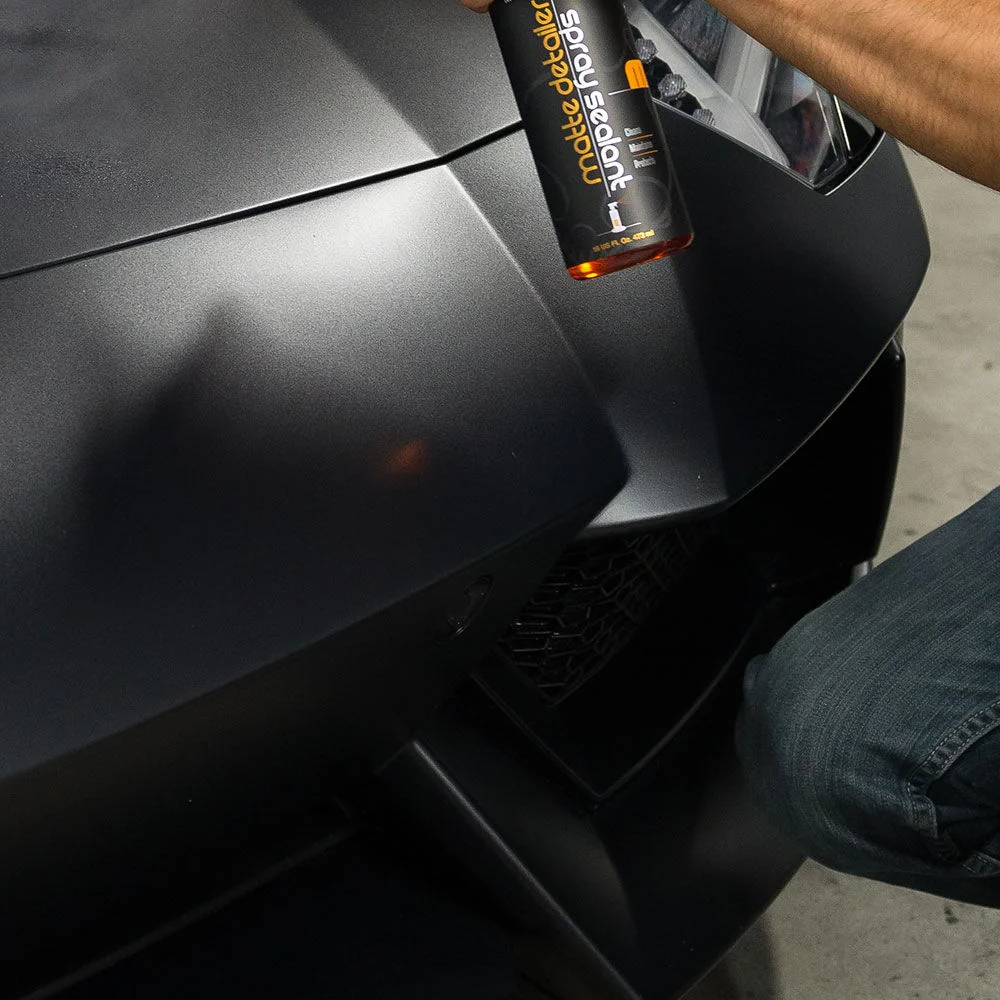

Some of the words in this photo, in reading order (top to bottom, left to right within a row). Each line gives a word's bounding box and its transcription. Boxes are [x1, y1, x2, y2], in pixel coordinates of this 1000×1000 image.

[530, 0, 575, 96] detailer
[558, 8, 599, 90] spray
[583, 90, 634, 192] sealant
[561, 98, 602, 186] matte
